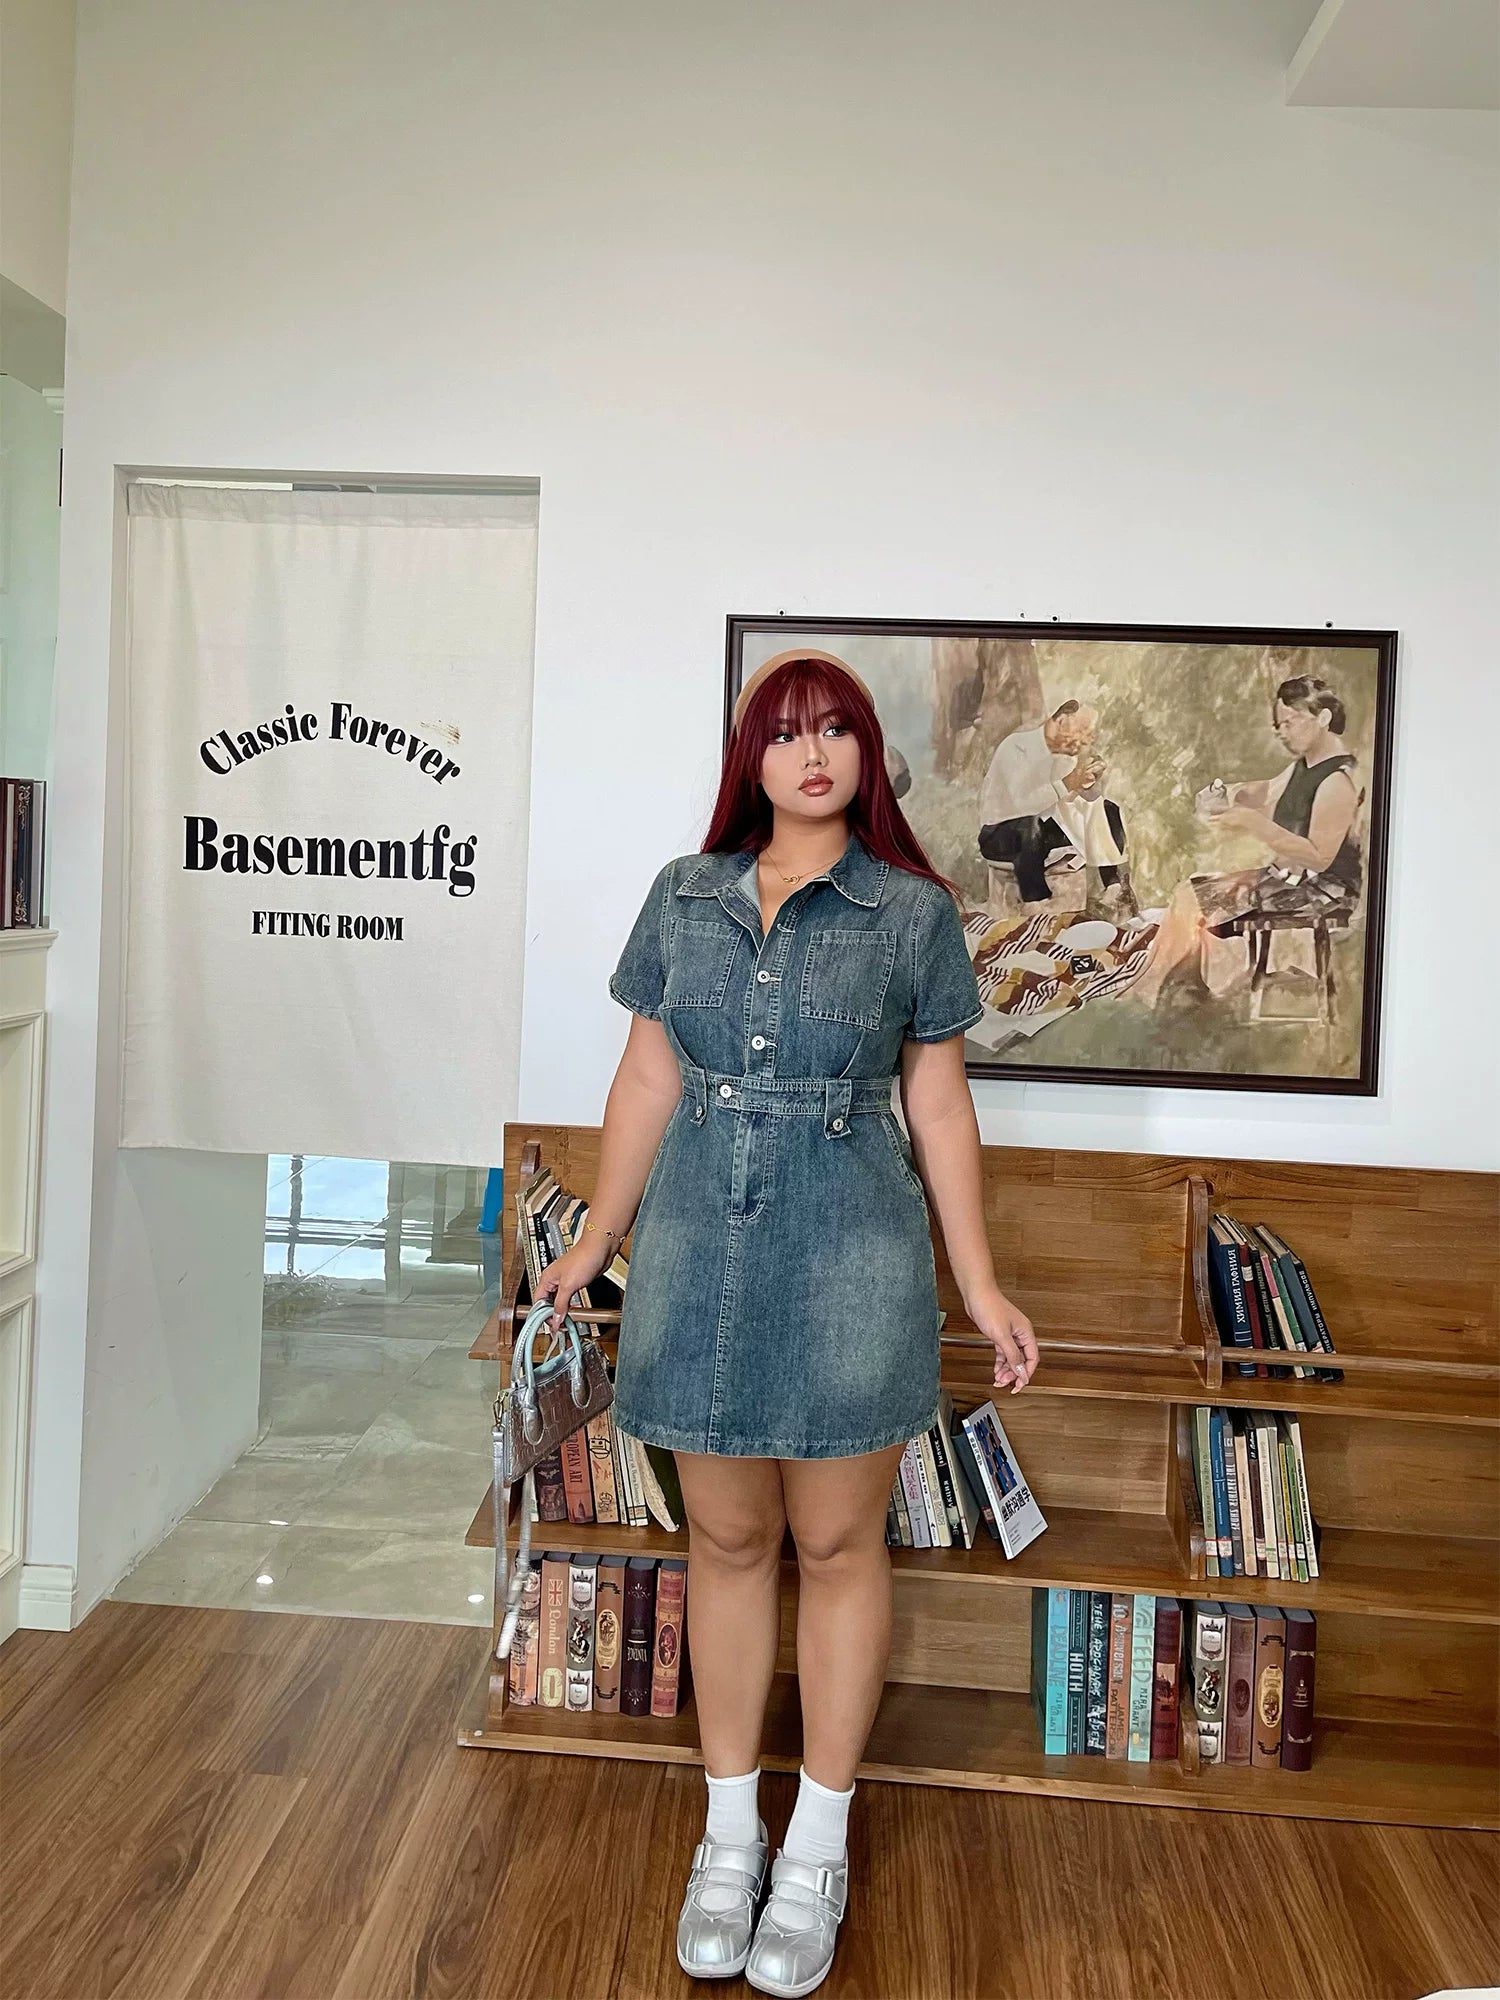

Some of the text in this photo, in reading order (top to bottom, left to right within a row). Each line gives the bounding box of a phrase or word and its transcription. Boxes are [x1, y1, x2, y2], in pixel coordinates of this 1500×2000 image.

[199, 701, 461, 785] Classic Forever
[182, 814, 478, 898] Basementfg
[251, 910, 405, 942] FITING ROOM
[1227, 1249, 1247, 1323] ХИМИЯ ГАФНИЯ
[569, 1471, 583, 1484] ART
[548, 1607, 562, 1655] London
[1069, 1652, 1084, 1692] HOTH
[1133, 1634, 1153, 1683] FEED
[1131, 1700, 1140, 1727] GRANT
[1140, 1687, 1148, 1710] MIRA
[1108, 1688, 1119, 1756] PATTERSON
[1116, 1703, 1125, 1742] JAMES
